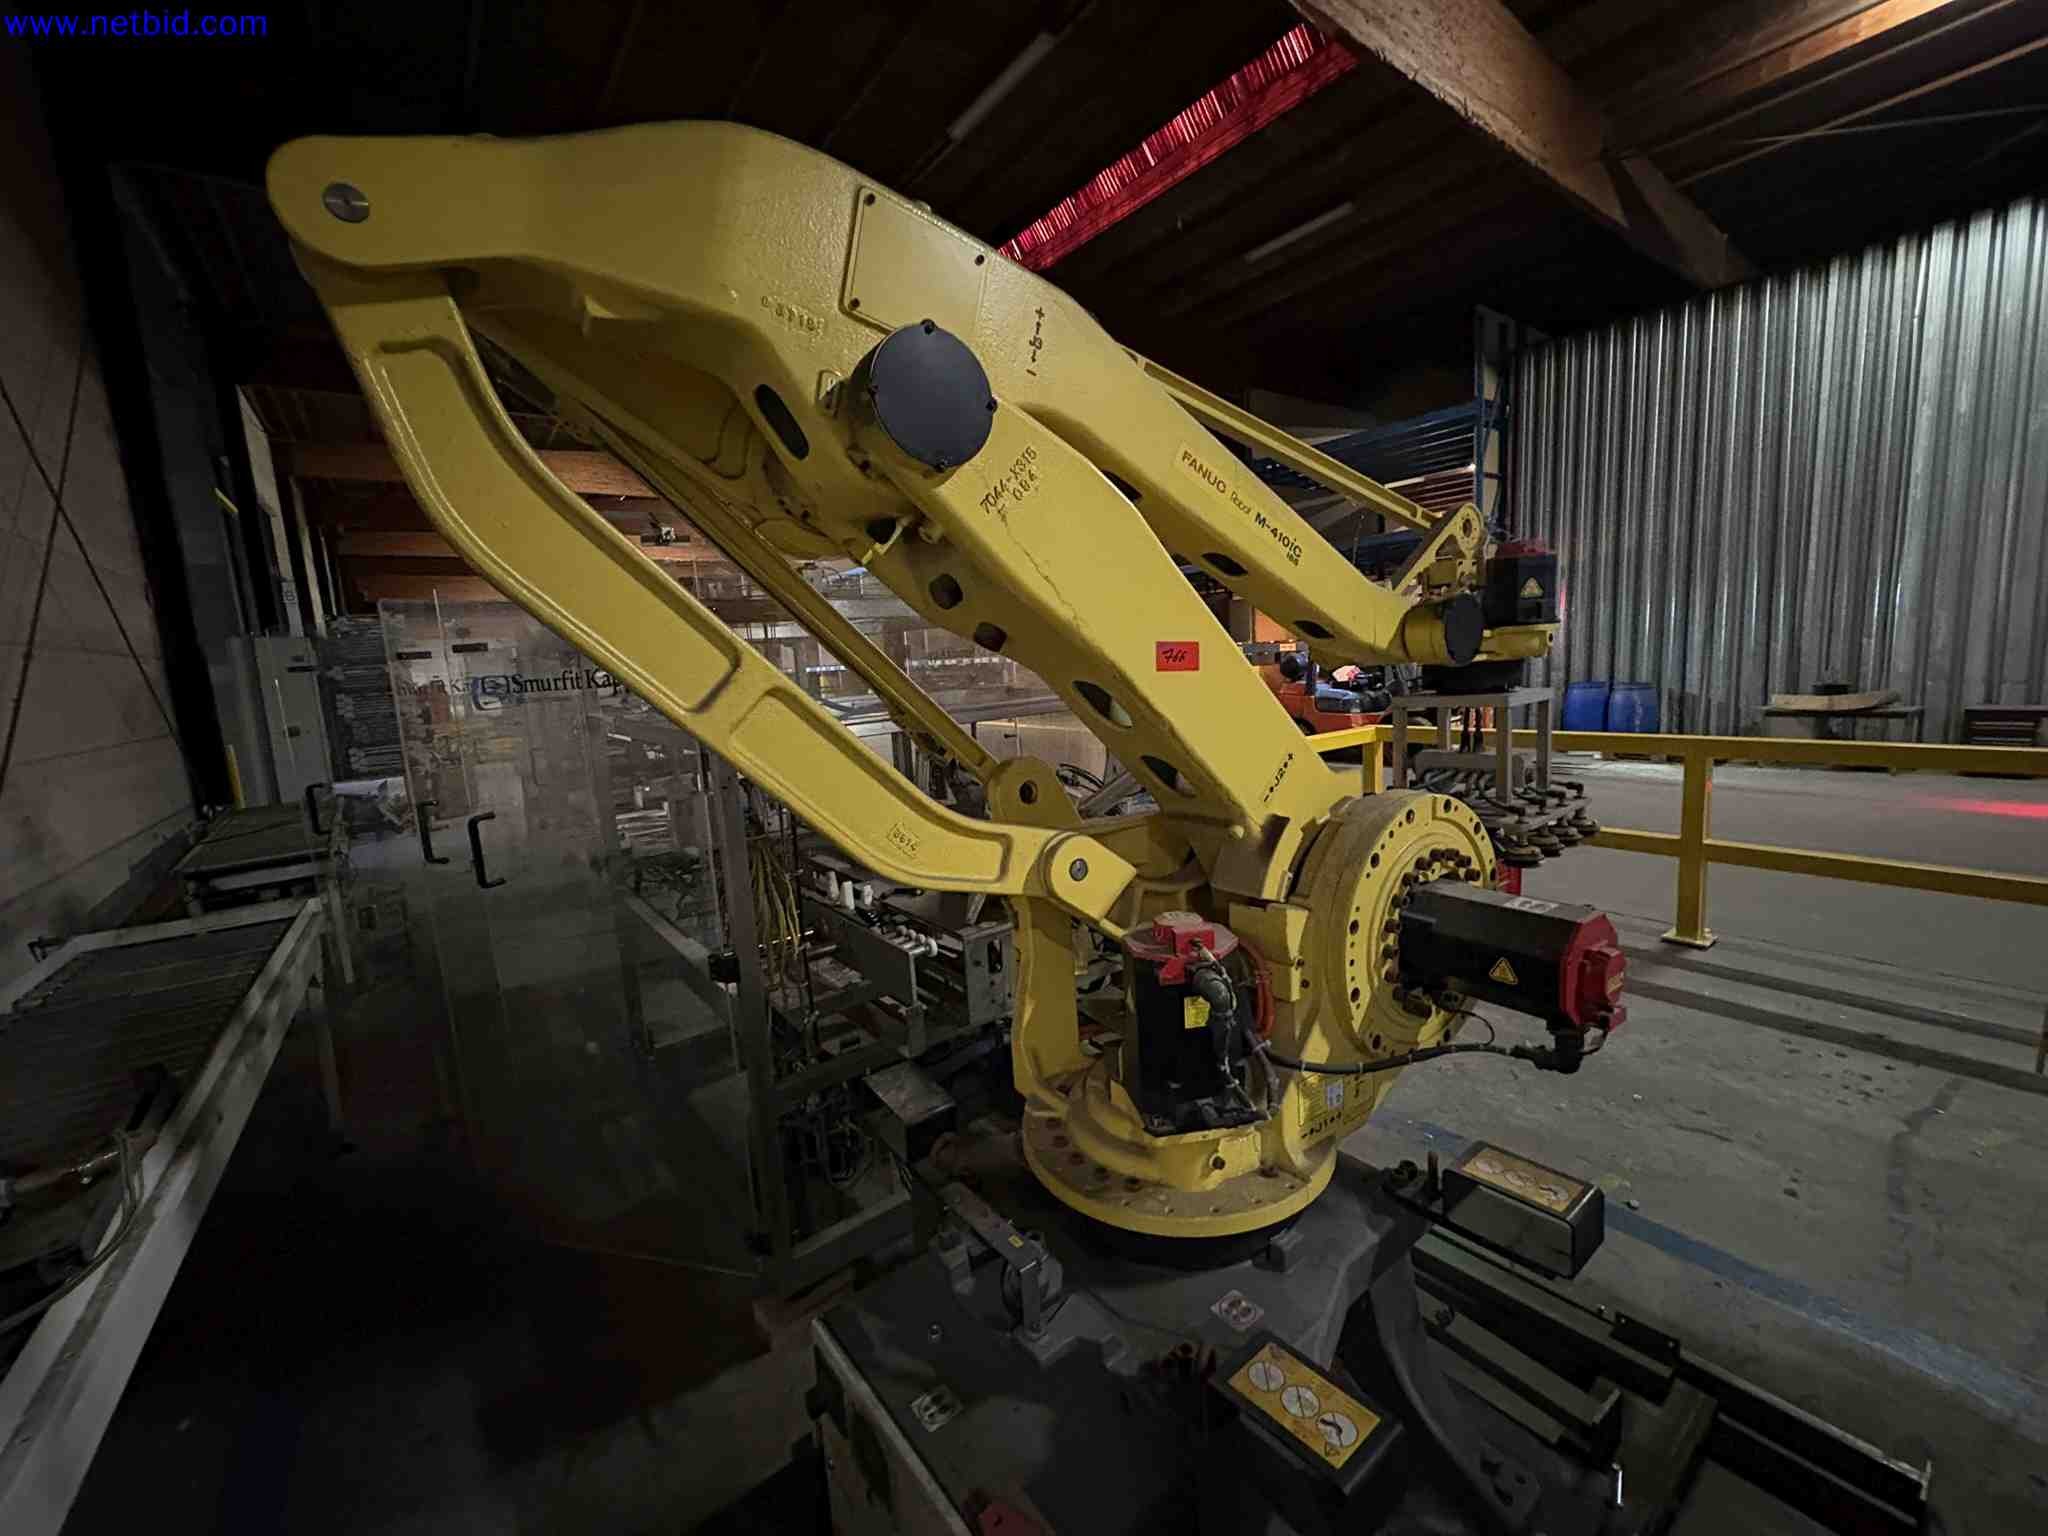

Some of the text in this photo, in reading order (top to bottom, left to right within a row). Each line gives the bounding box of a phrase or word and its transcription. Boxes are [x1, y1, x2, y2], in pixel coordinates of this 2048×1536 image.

[1181, 450, 1227, 494] FANUC
[1254, 511, 1303, 559] M-410iC
[512, 667, 625, 696] Smurfit Kap
